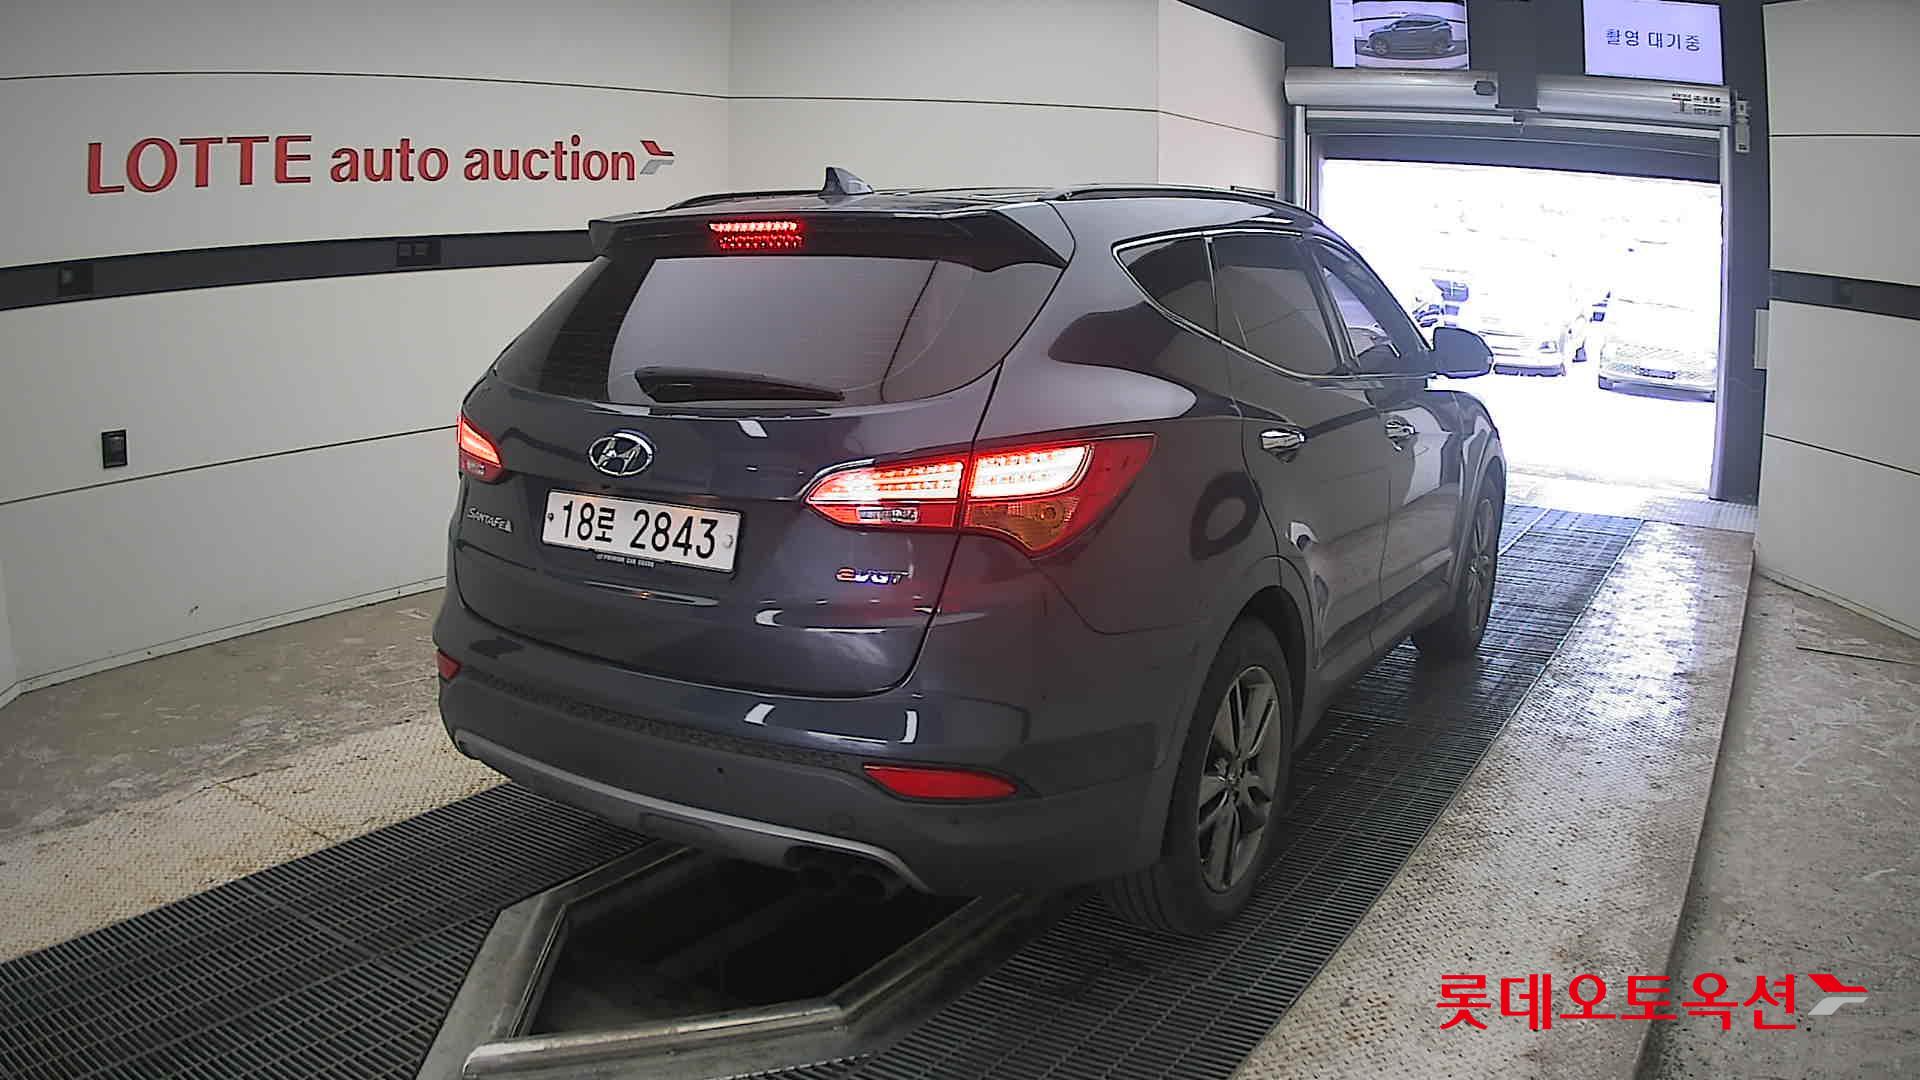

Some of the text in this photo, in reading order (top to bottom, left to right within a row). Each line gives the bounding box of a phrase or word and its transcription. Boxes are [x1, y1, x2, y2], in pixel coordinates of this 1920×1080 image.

[1606, 29, 1700, 52] 촬영 대기중
[87, 134, 636, 195] LOTTE auto auction
[563, 500, 719, 559] 18로 2843
